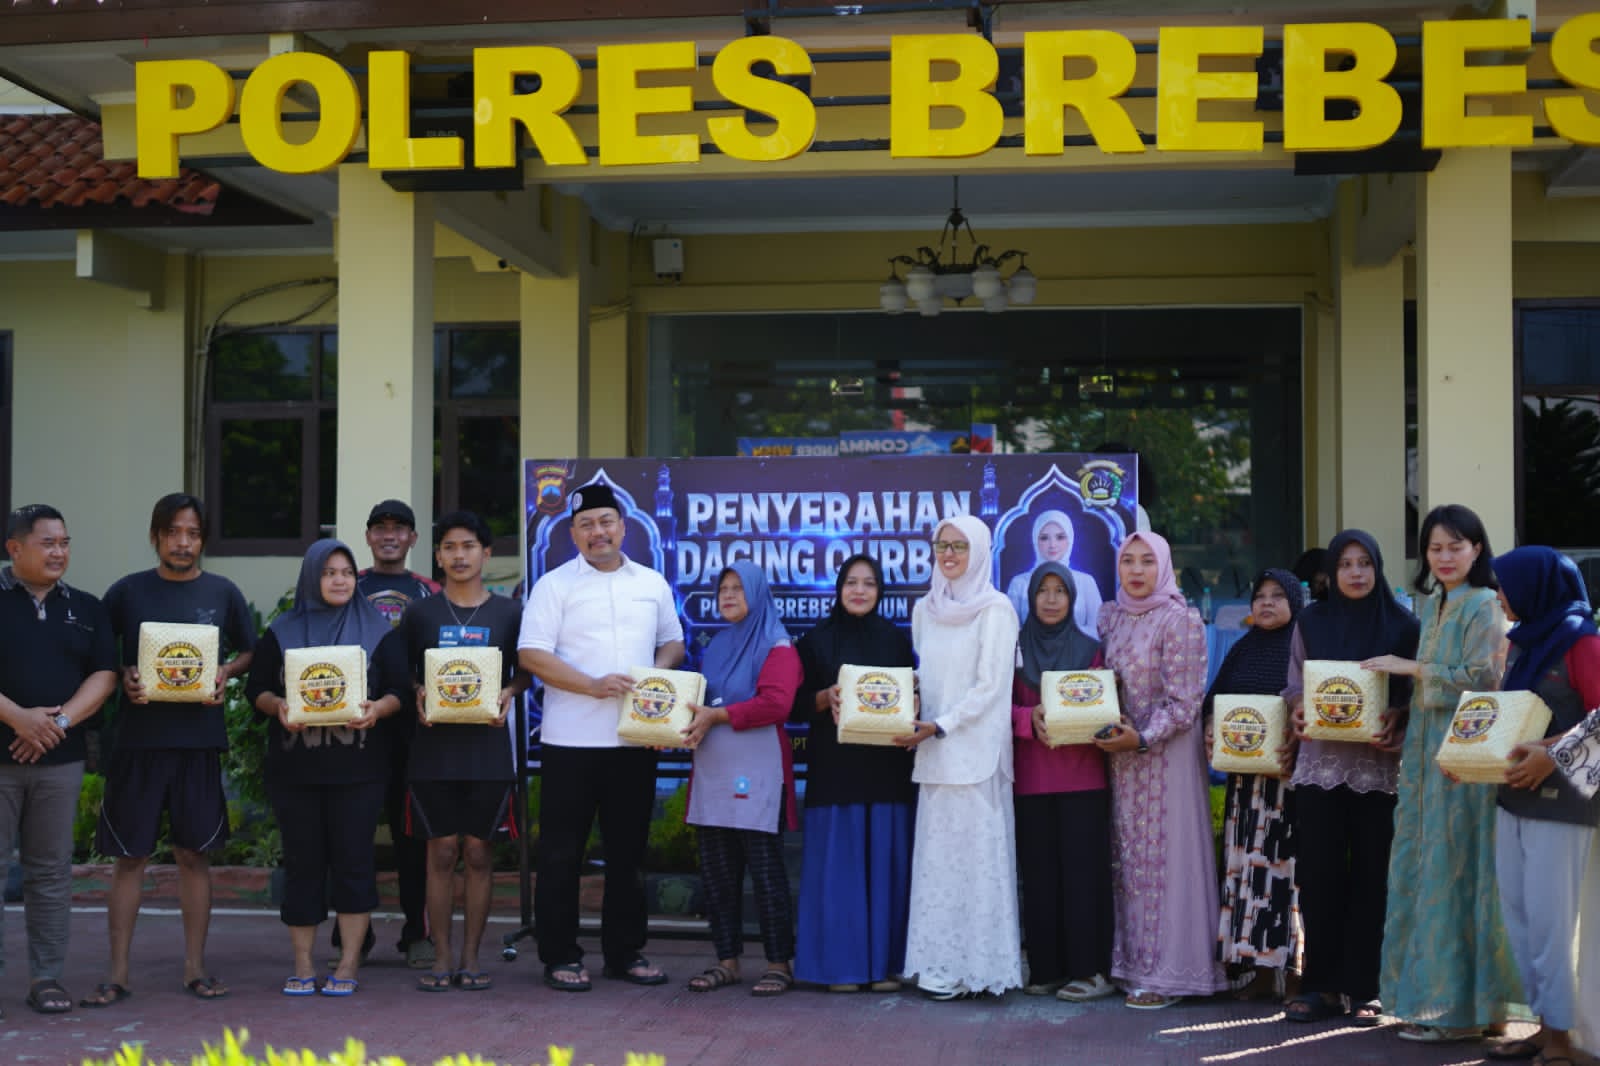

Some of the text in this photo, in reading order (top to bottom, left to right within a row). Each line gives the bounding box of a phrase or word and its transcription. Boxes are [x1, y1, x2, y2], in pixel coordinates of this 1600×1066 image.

[135, 35, 817, 179] POLRES
[687, 491, 971, 534] PENYERAHAN
[774, 597, 837, 618] BREBE
